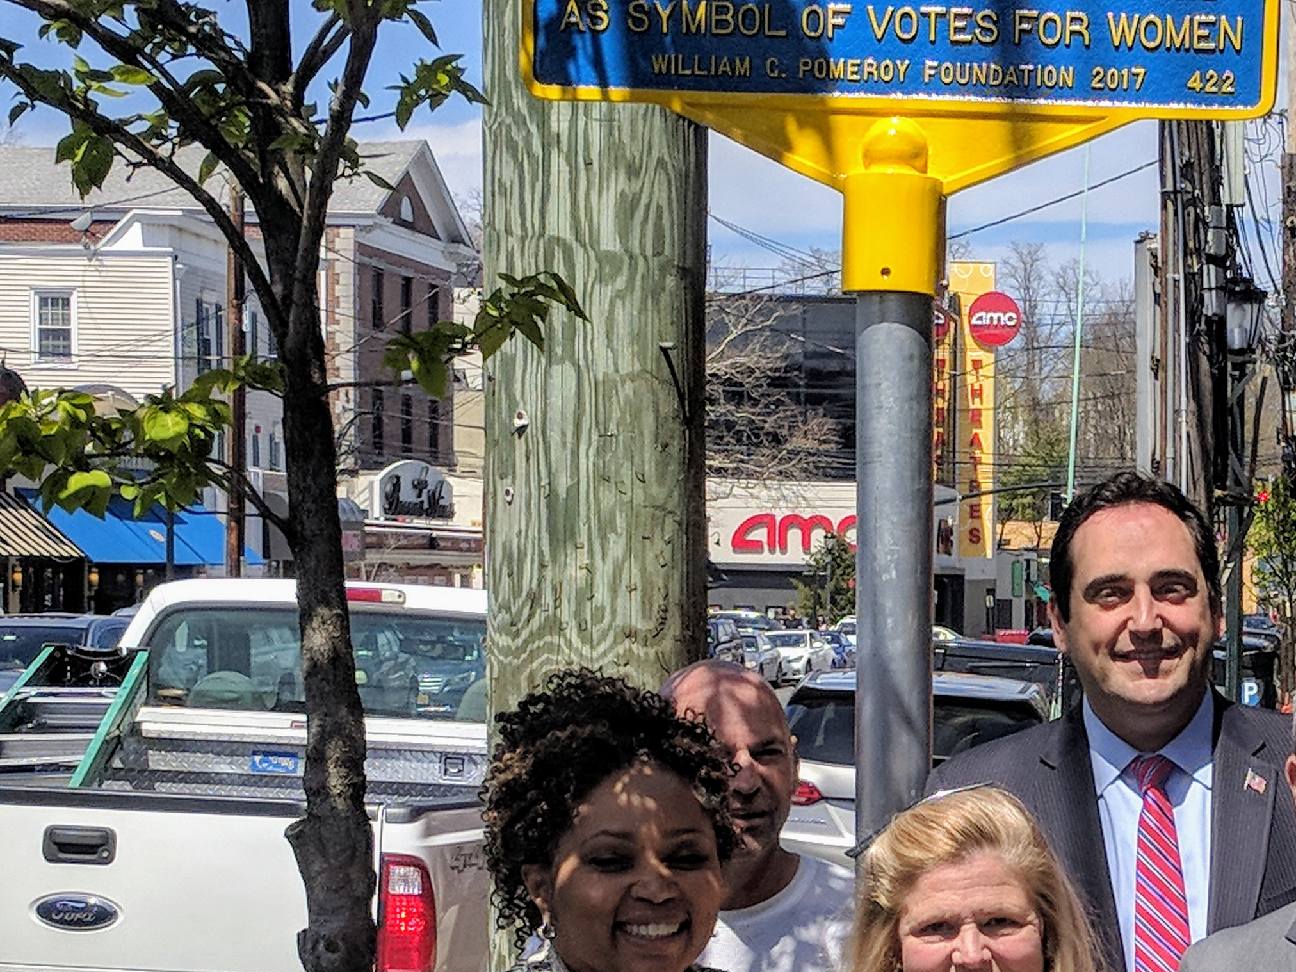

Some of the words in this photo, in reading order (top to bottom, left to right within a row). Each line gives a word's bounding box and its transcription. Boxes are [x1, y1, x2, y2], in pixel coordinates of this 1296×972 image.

[560, 2, 610, 33] AS
[628, 1, 787, 37] SYMBOL
[802, 3, 851, 38] OF
[868, 5, 998, 44] VOTES
[1015, 9, 1090, 47] FOR
[1108, 12, 1244, 51] WOMEN
[652, 54, 750, 78] WILLIAM
[799, 58, 911, 83] POMEROY
[924, 60, 1074, 89] FOUNDATION
[1091, 67, 1146, 91] 2017
[1187, 70, 1235, 94] 422
[971, 311, 1018, 327] amc
[1242, 682, 1259, 704] P
[52, 899, 97, 923] Ford
